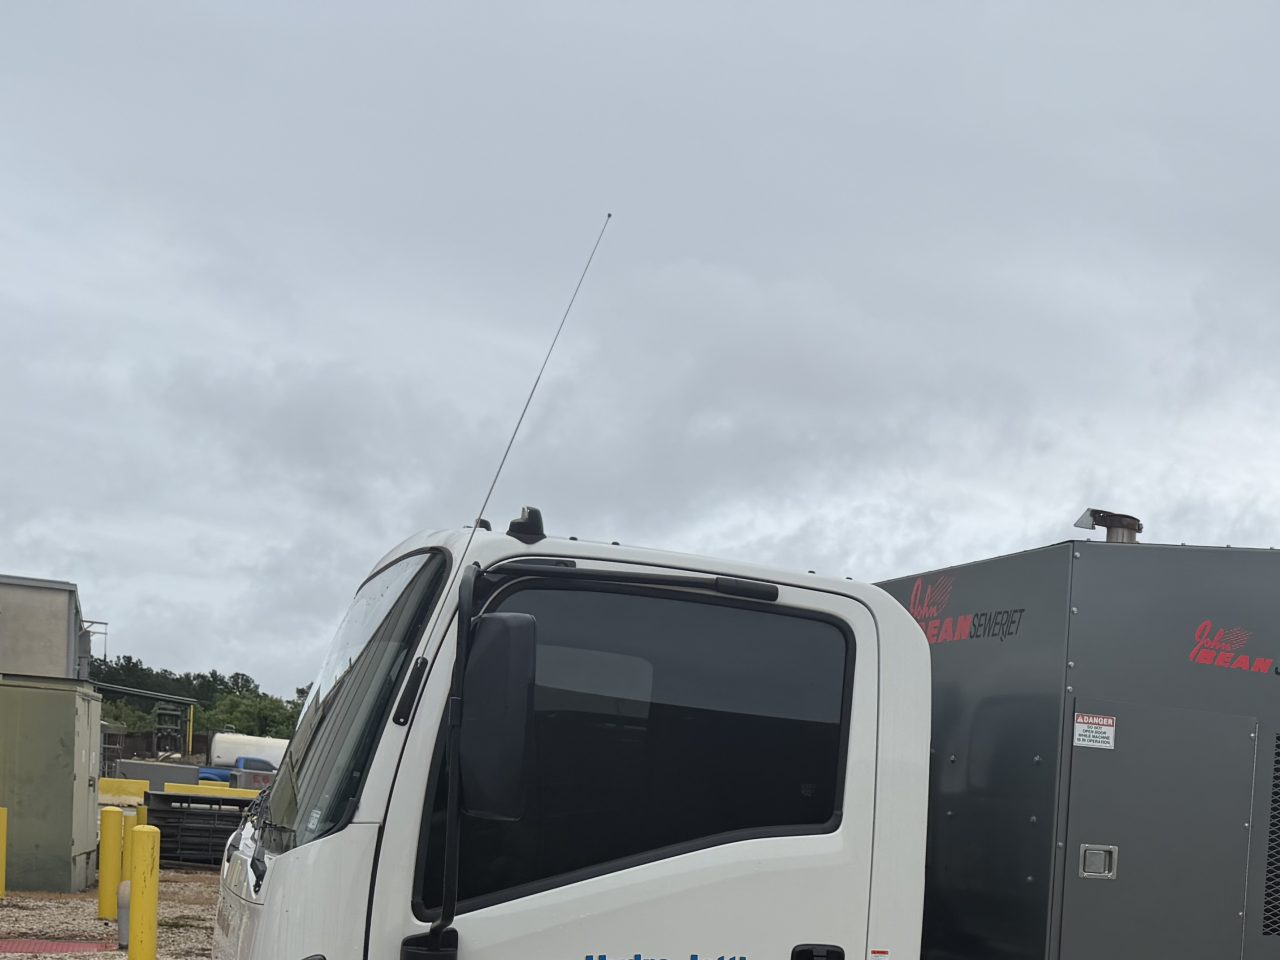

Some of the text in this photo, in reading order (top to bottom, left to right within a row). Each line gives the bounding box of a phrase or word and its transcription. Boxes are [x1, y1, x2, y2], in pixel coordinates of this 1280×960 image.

[921, 609, 1025, 644] EAN SEWERJET
[1189, 620, 1231, 661] John
[1197, 649, 1274, 673] BEAN
[1083, 716, 1113, 726] DANGER
